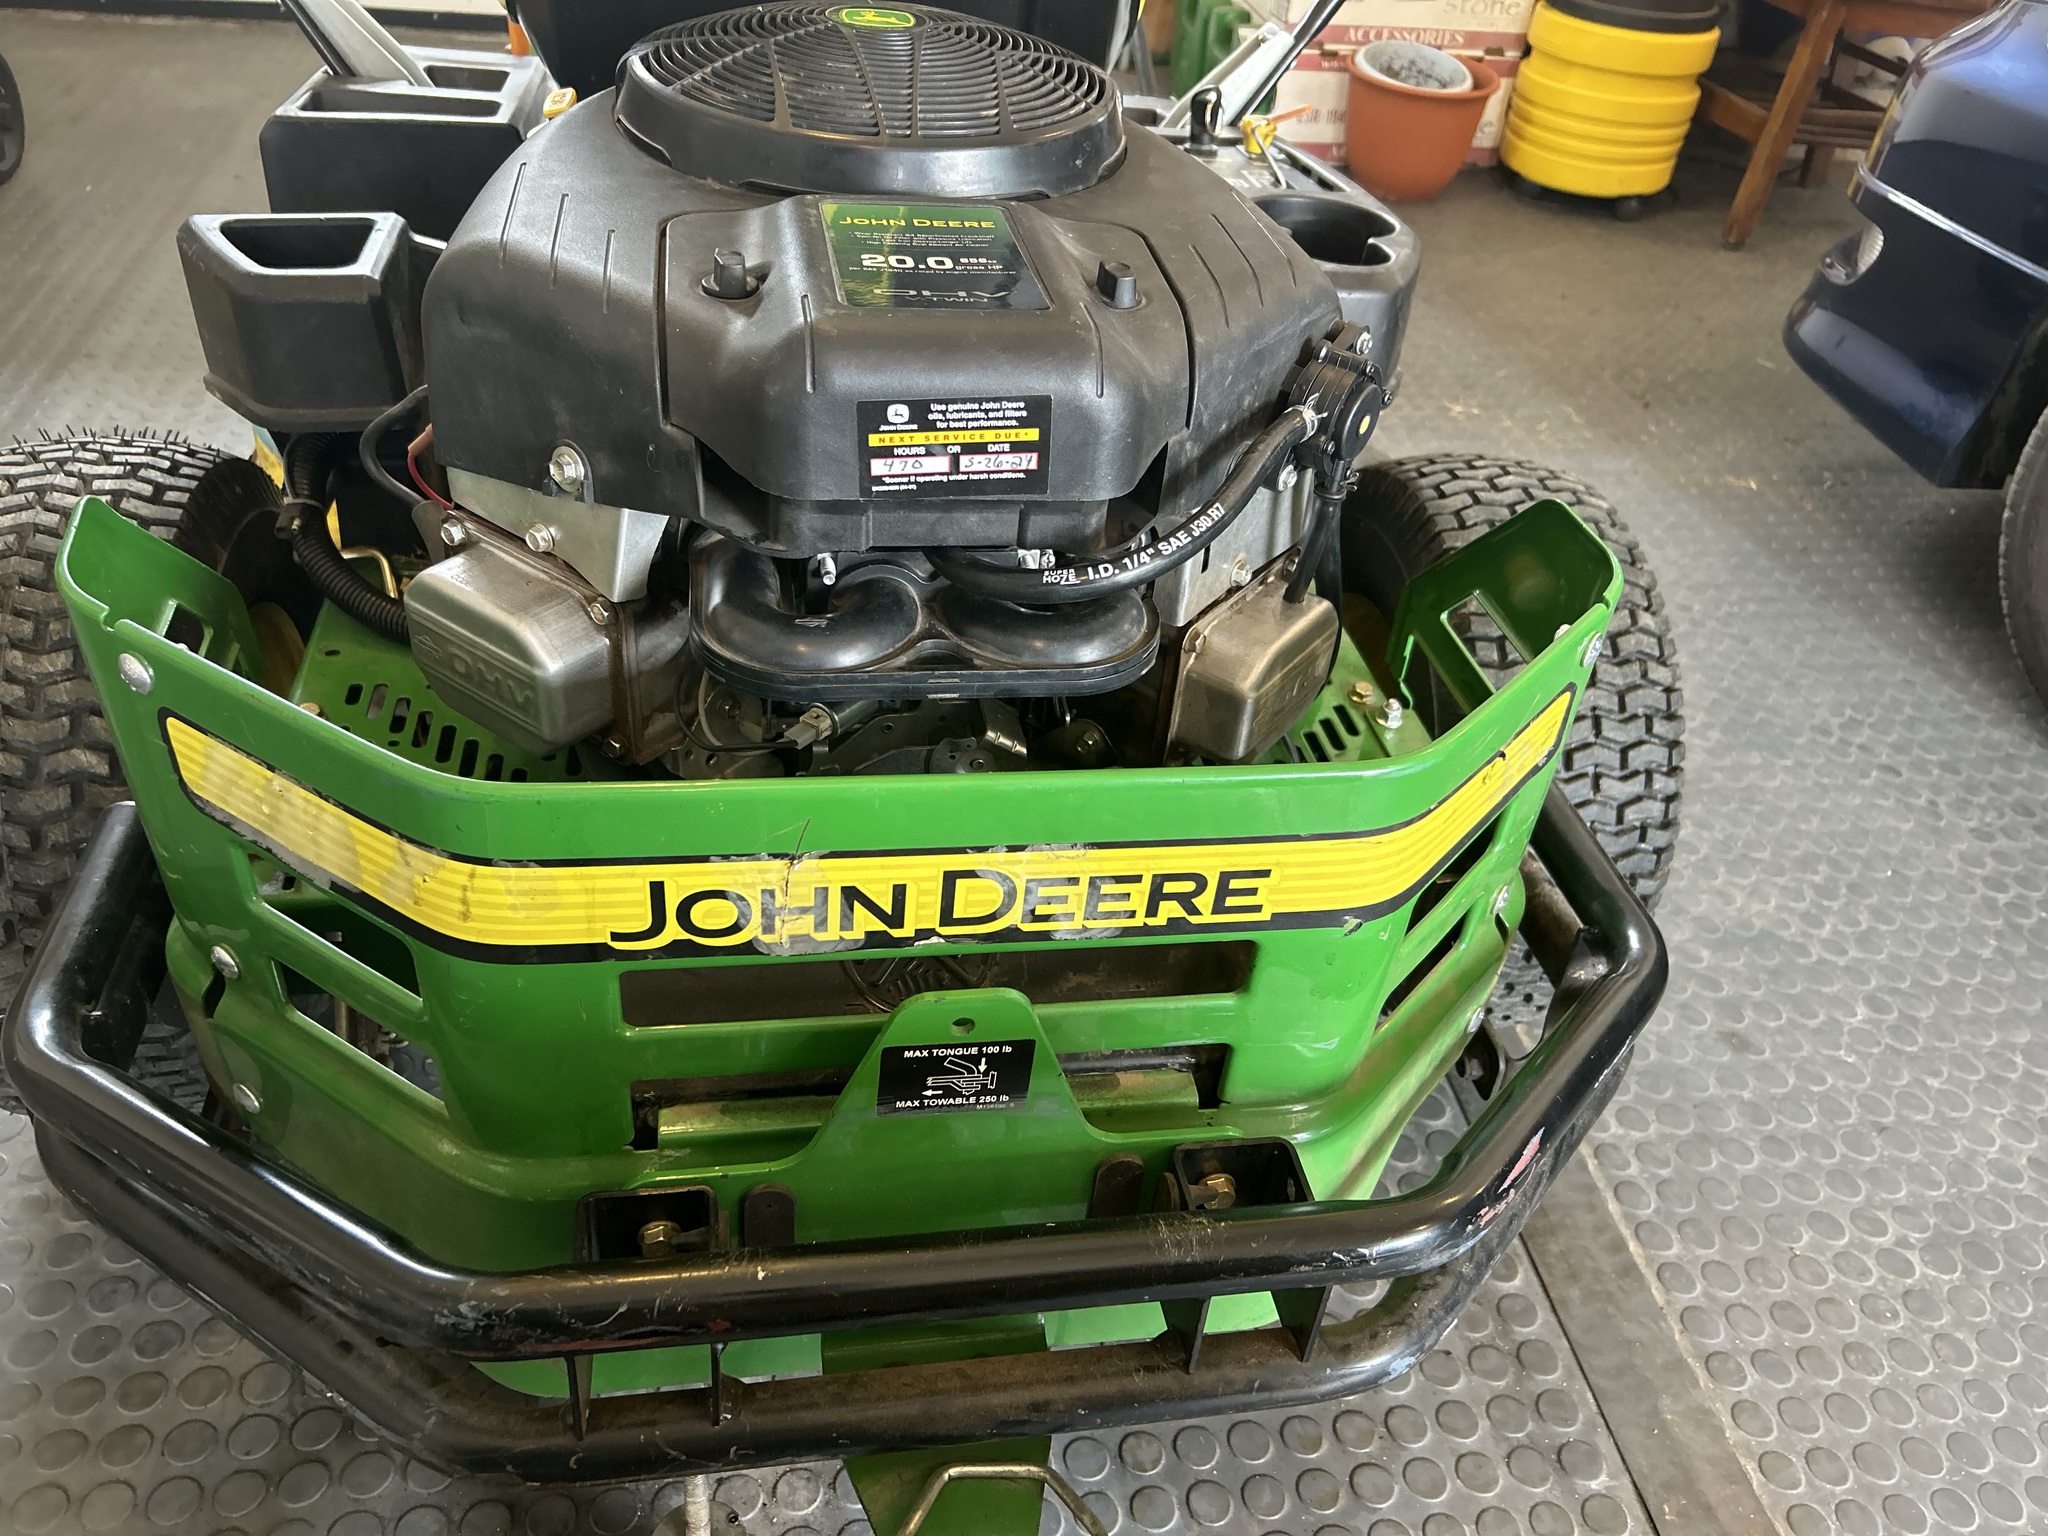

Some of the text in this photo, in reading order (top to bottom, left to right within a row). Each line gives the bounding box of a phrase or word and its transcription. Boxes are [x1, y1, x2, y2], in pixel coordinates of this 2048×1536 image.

[1344, 26, 1465, 46] ACCESSORIES
[838, 217, 996, 229] JOHN DEERE
[860, 253, 954, 269] 20.0
[872, 288, 1012, 298] OHV
[930, 401, 1025, 412] Use genuine John Deere
[927, 409, 1028, 420] oils, lubricants, and filters
[936, 419, 1020, 429] for best performance.
[924, 433, 985, 442] SERVICE
[894, 444, 1011, 456] HOURS OR DATE
[883, 459, 924, 472] 470
[916, 474, 948, 484] operating
[948, 473, 969, 481] under
[969, 472, 989, 480] harsh
[989, 471, 1027, 479] conditions.
[1087, 563, 1120, 581] I.D.
[1122, 546, 1155, 571] 1/4"
[1157, 530, 1193, 555] SAE
[1043, 568, 1077, 576] SUPER
[1042, 574, 1081, 585] HOZE
[608, 868, 1273, 943] JOHN DEERE
[903, 1044, 1013, 1058] MAX TONGUE 100 lb
[895, 1099, 921, 1108] MAX
[922, 1096, 977, 1107] TOWABLE
[978, 1095, 998, 1103] 250
[999, 1094, 1010, 1102] lb
